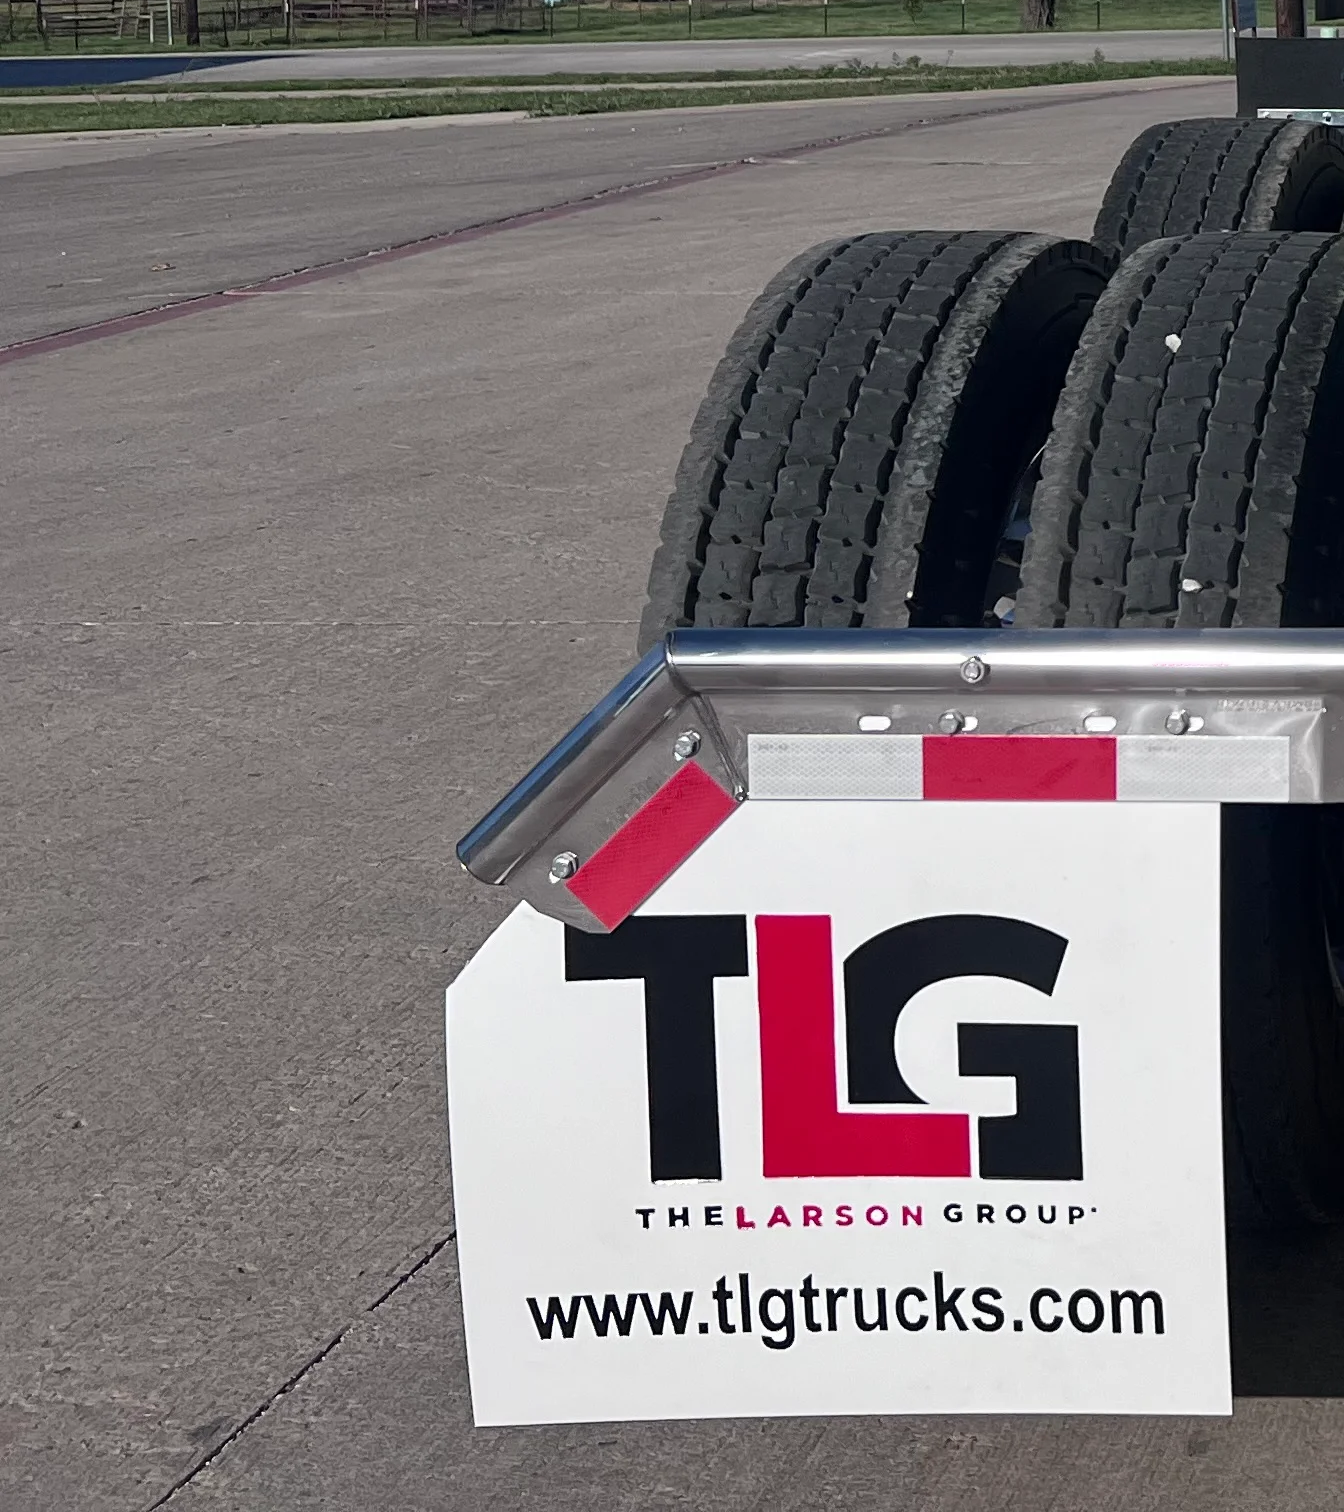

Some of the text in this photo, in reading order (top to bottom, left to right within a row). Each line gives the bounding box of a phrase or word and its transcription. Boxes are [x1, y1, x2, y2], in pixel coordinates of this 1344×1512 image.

[564, 913, 1083, 1185] TLG
[943, 1203, 1085, 1225] GROUP
[525, 1270, 1165, 1350] www.tlgtrucks.com
